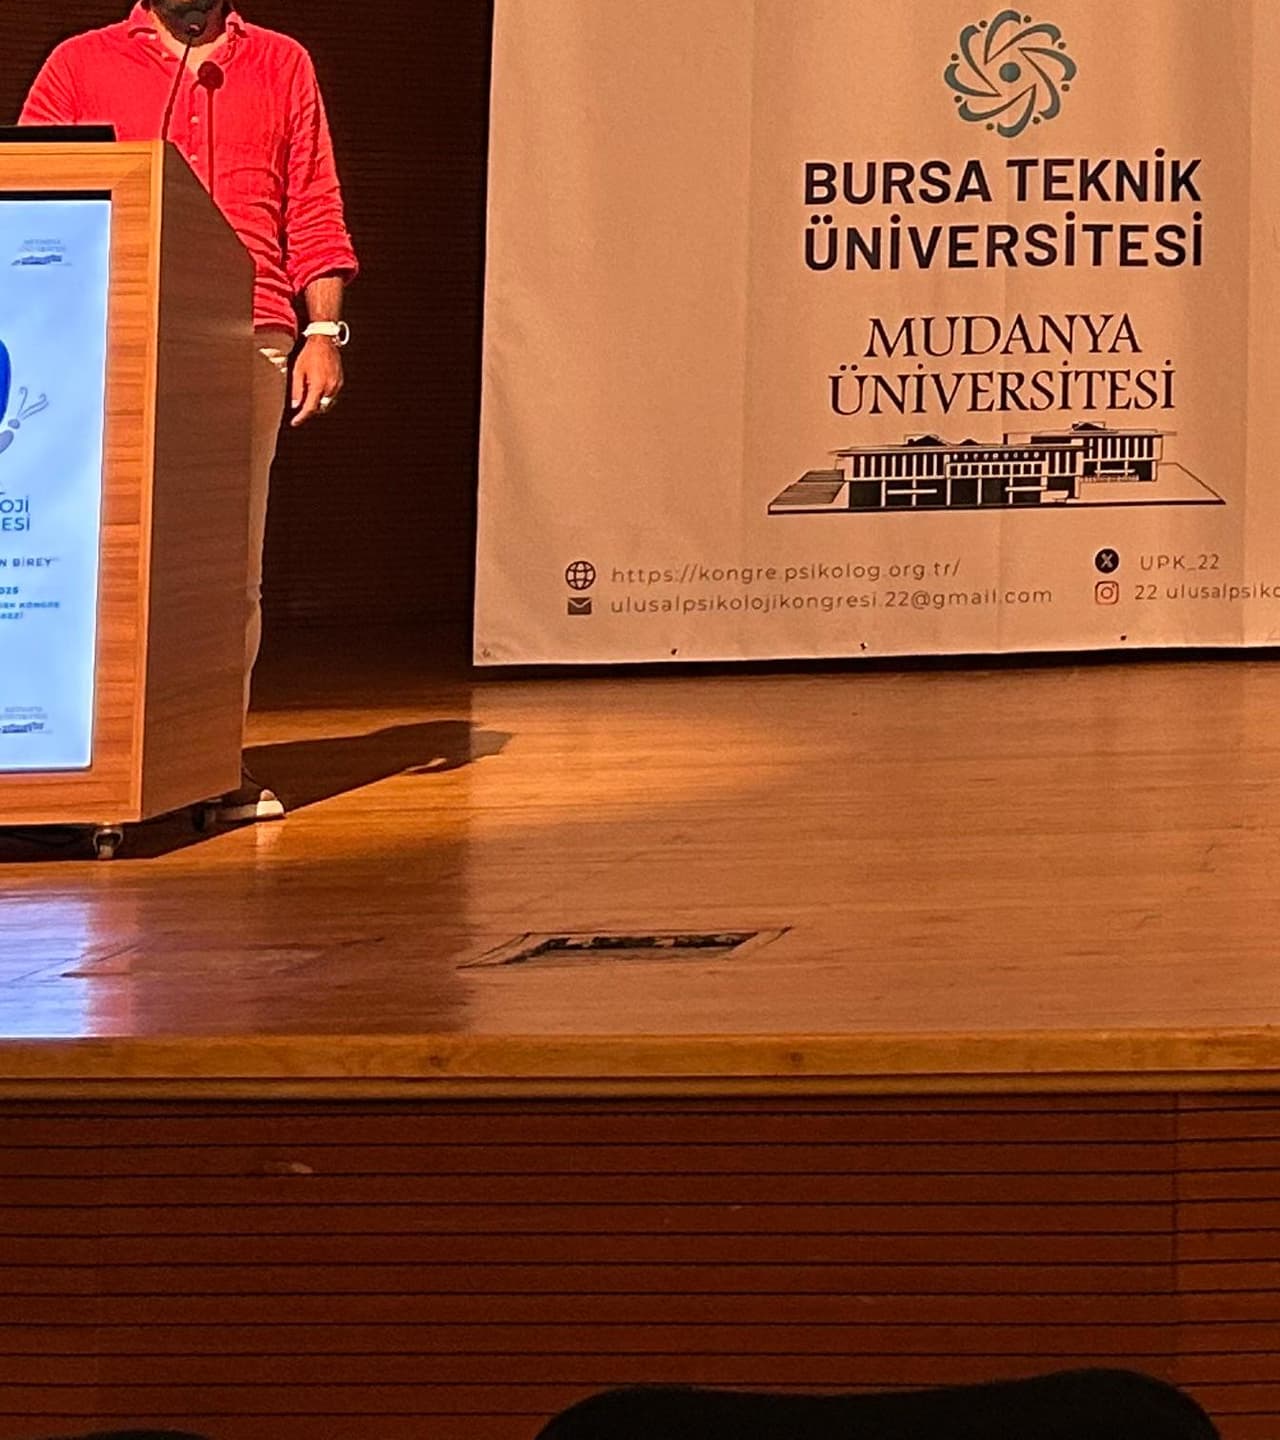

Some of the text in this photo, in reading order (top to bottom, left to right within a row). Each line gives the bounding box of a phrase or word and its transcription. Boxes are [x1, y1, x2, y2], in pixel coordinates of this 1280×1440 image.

[804, 148, 1202, 205] BURSA TEKNİK
[804, 211, 1203, 271] ÜNİVERSİTESİ
[863, 313, 1142, 358] MUDANYA
[829, 360, 1176, 416] ÜNİVERSİTESİ
[1140, 554, 1220, 571] UPK_22
